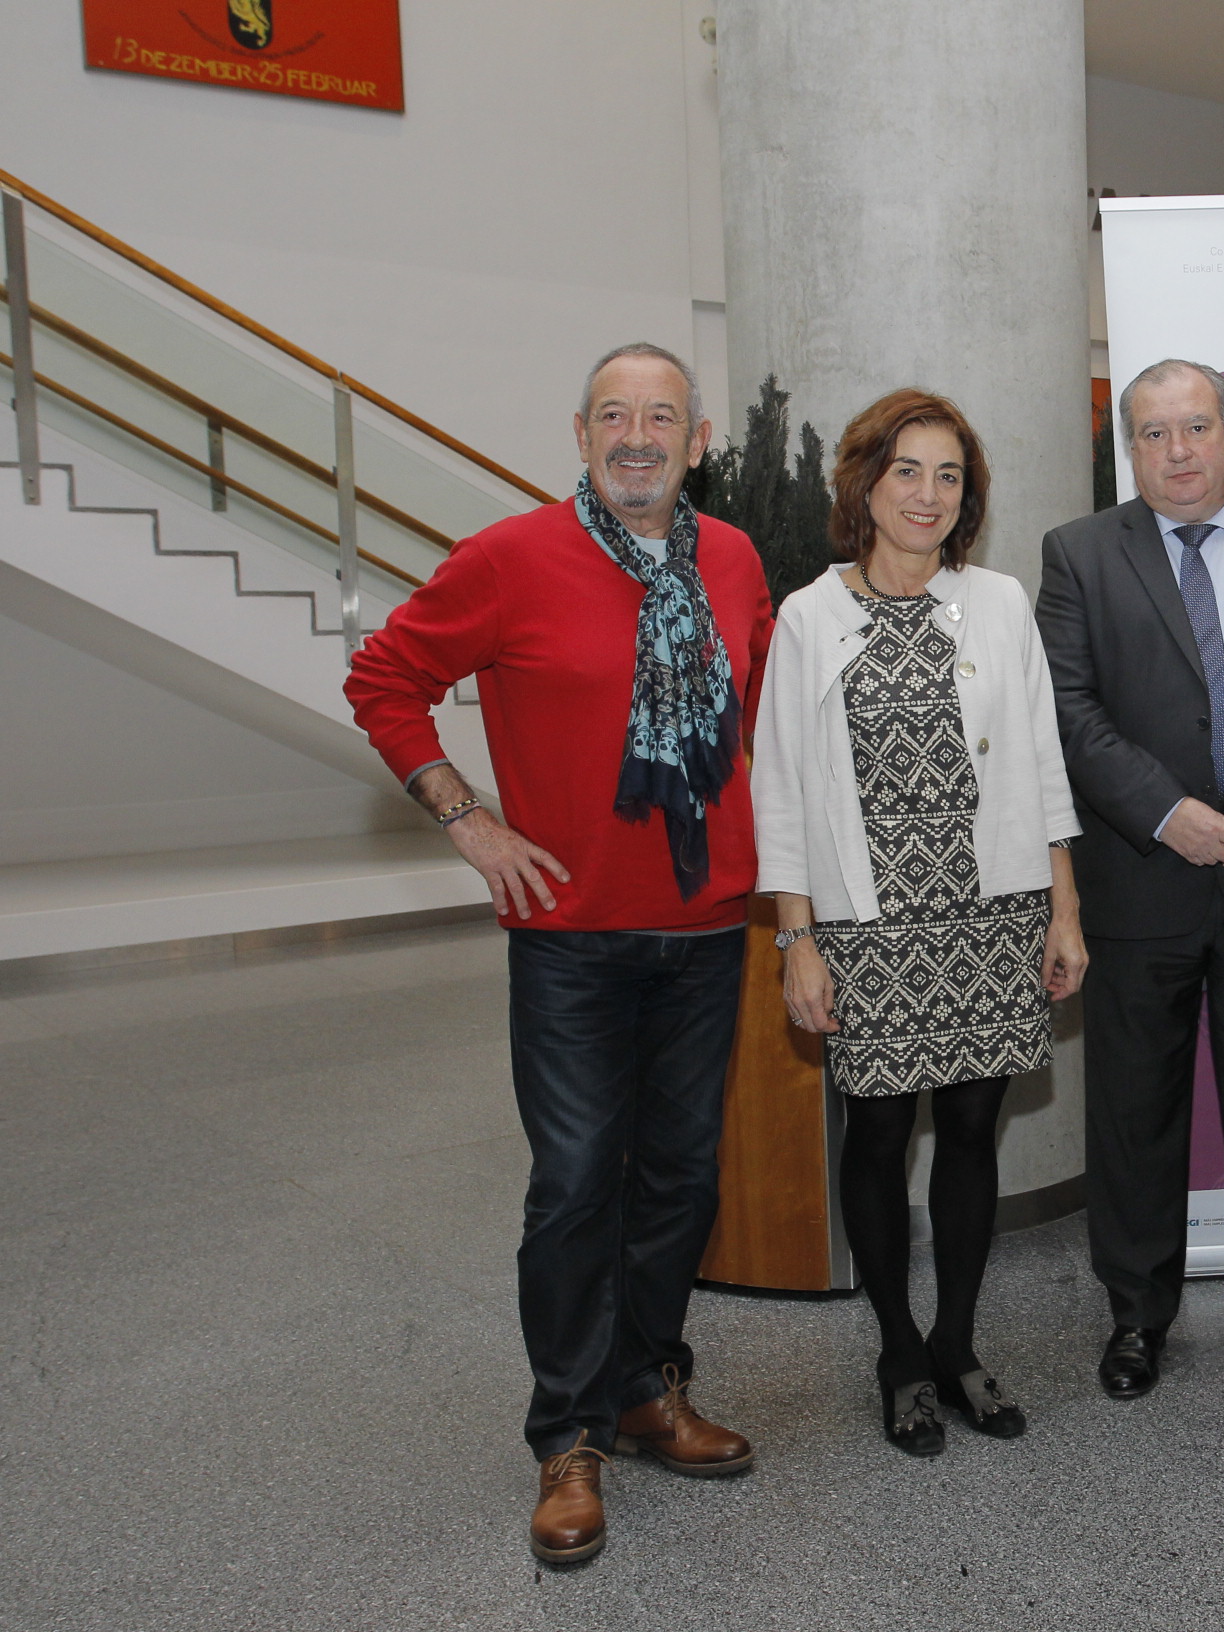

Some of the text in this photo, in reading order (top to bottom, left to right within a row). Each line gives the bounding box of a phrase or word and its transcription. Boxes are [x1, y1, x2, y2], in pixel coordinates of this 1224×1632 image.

[113, 36, 139, 64] 13
[287, 69, 378, 98] FEBRUAR
[1182, 263, 1214, 274] Euskal
